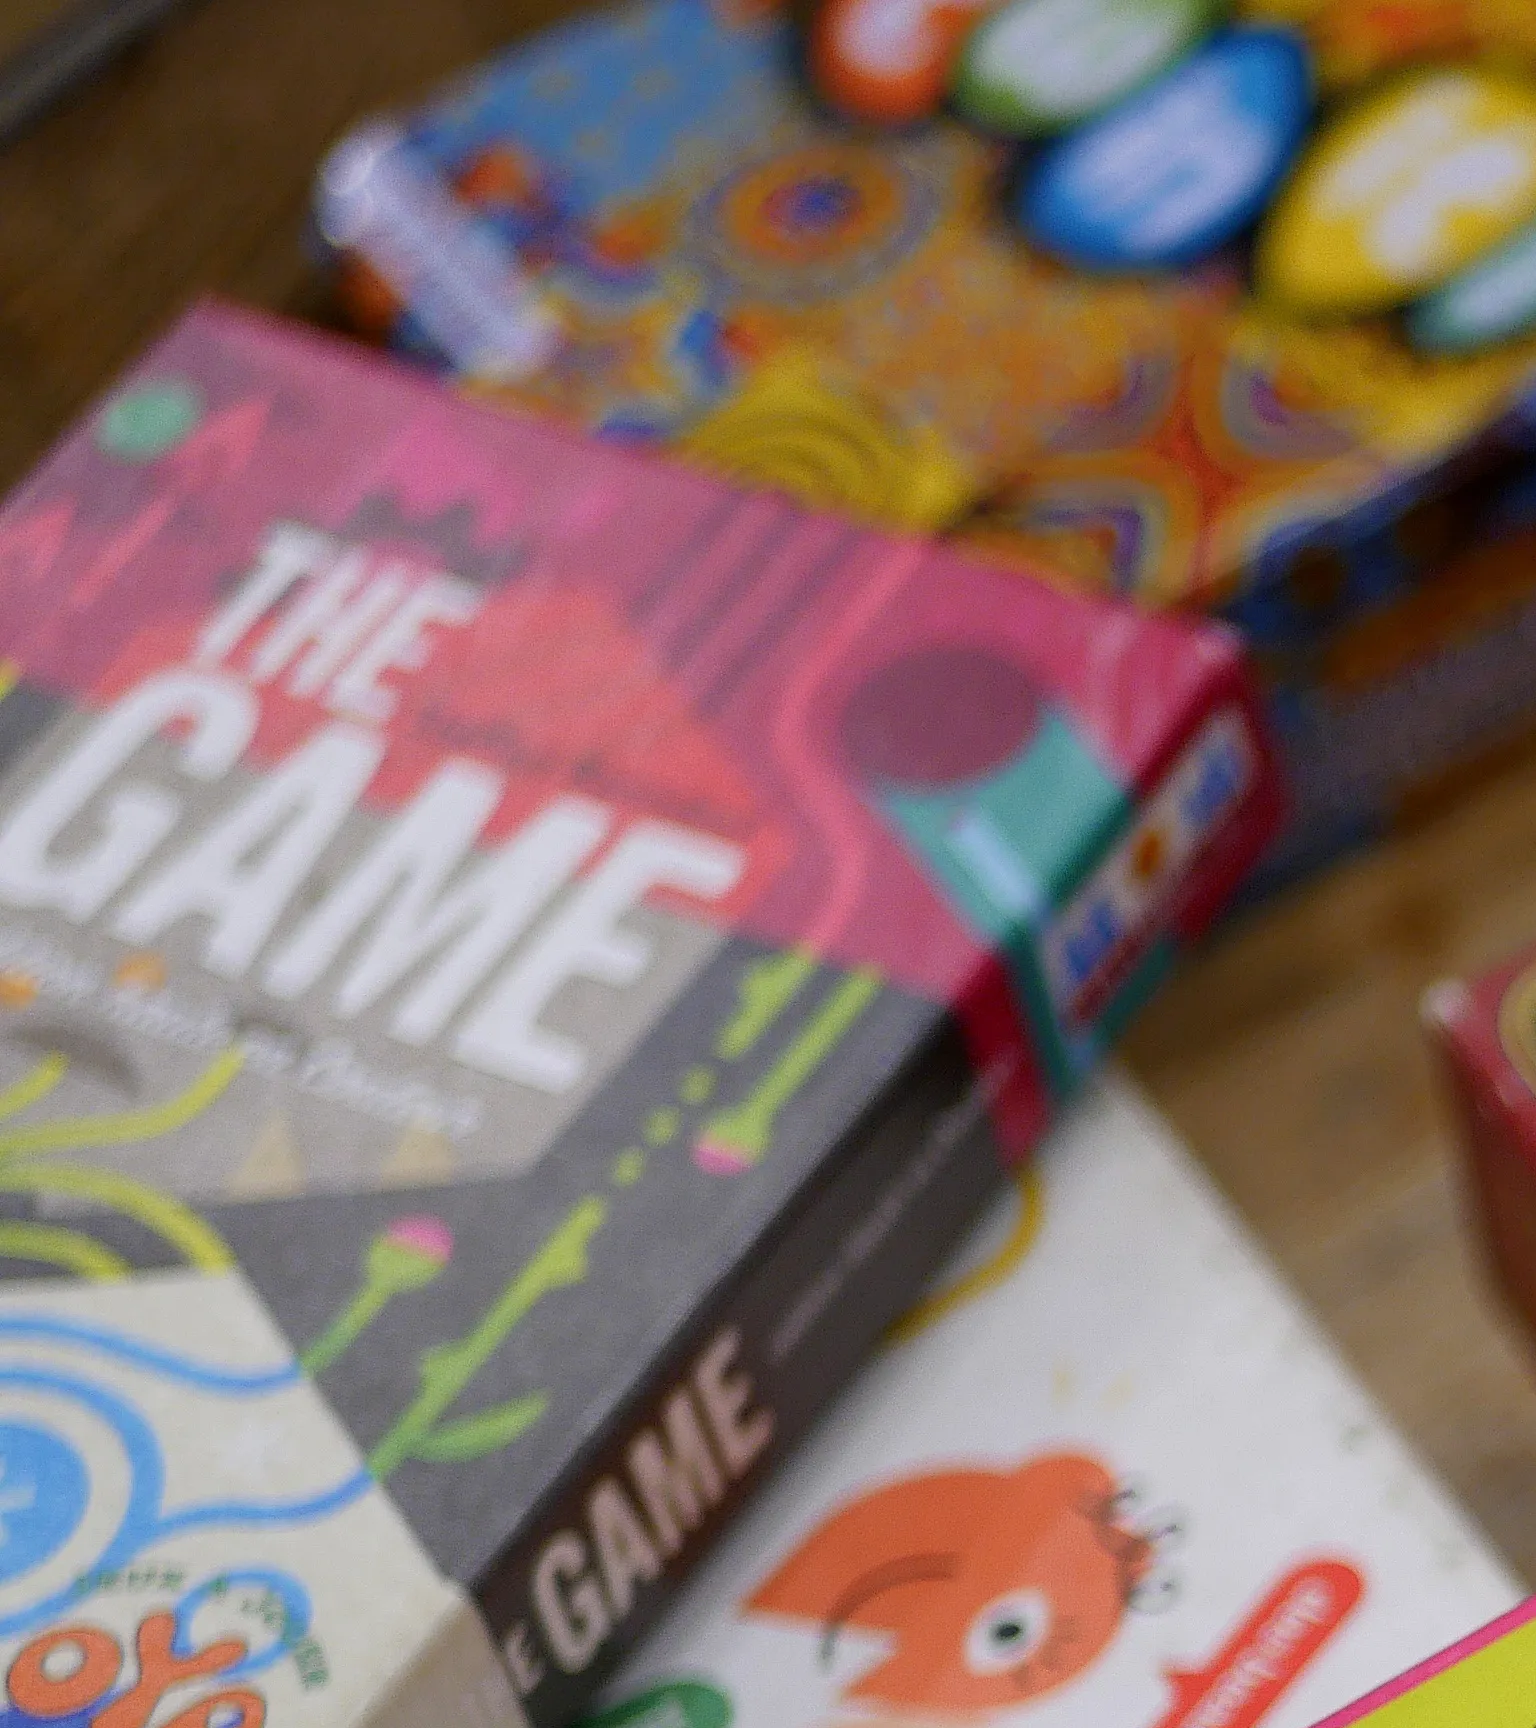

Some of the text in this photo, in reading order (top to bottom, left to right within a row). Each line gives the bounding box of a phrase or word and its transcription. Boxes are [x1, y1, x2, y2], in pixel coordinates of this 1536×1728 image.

[190, 519, 484, 717] THE
[0, 668, 745, 1094] GAME
[533, 1328, 775, 1672] GAME
